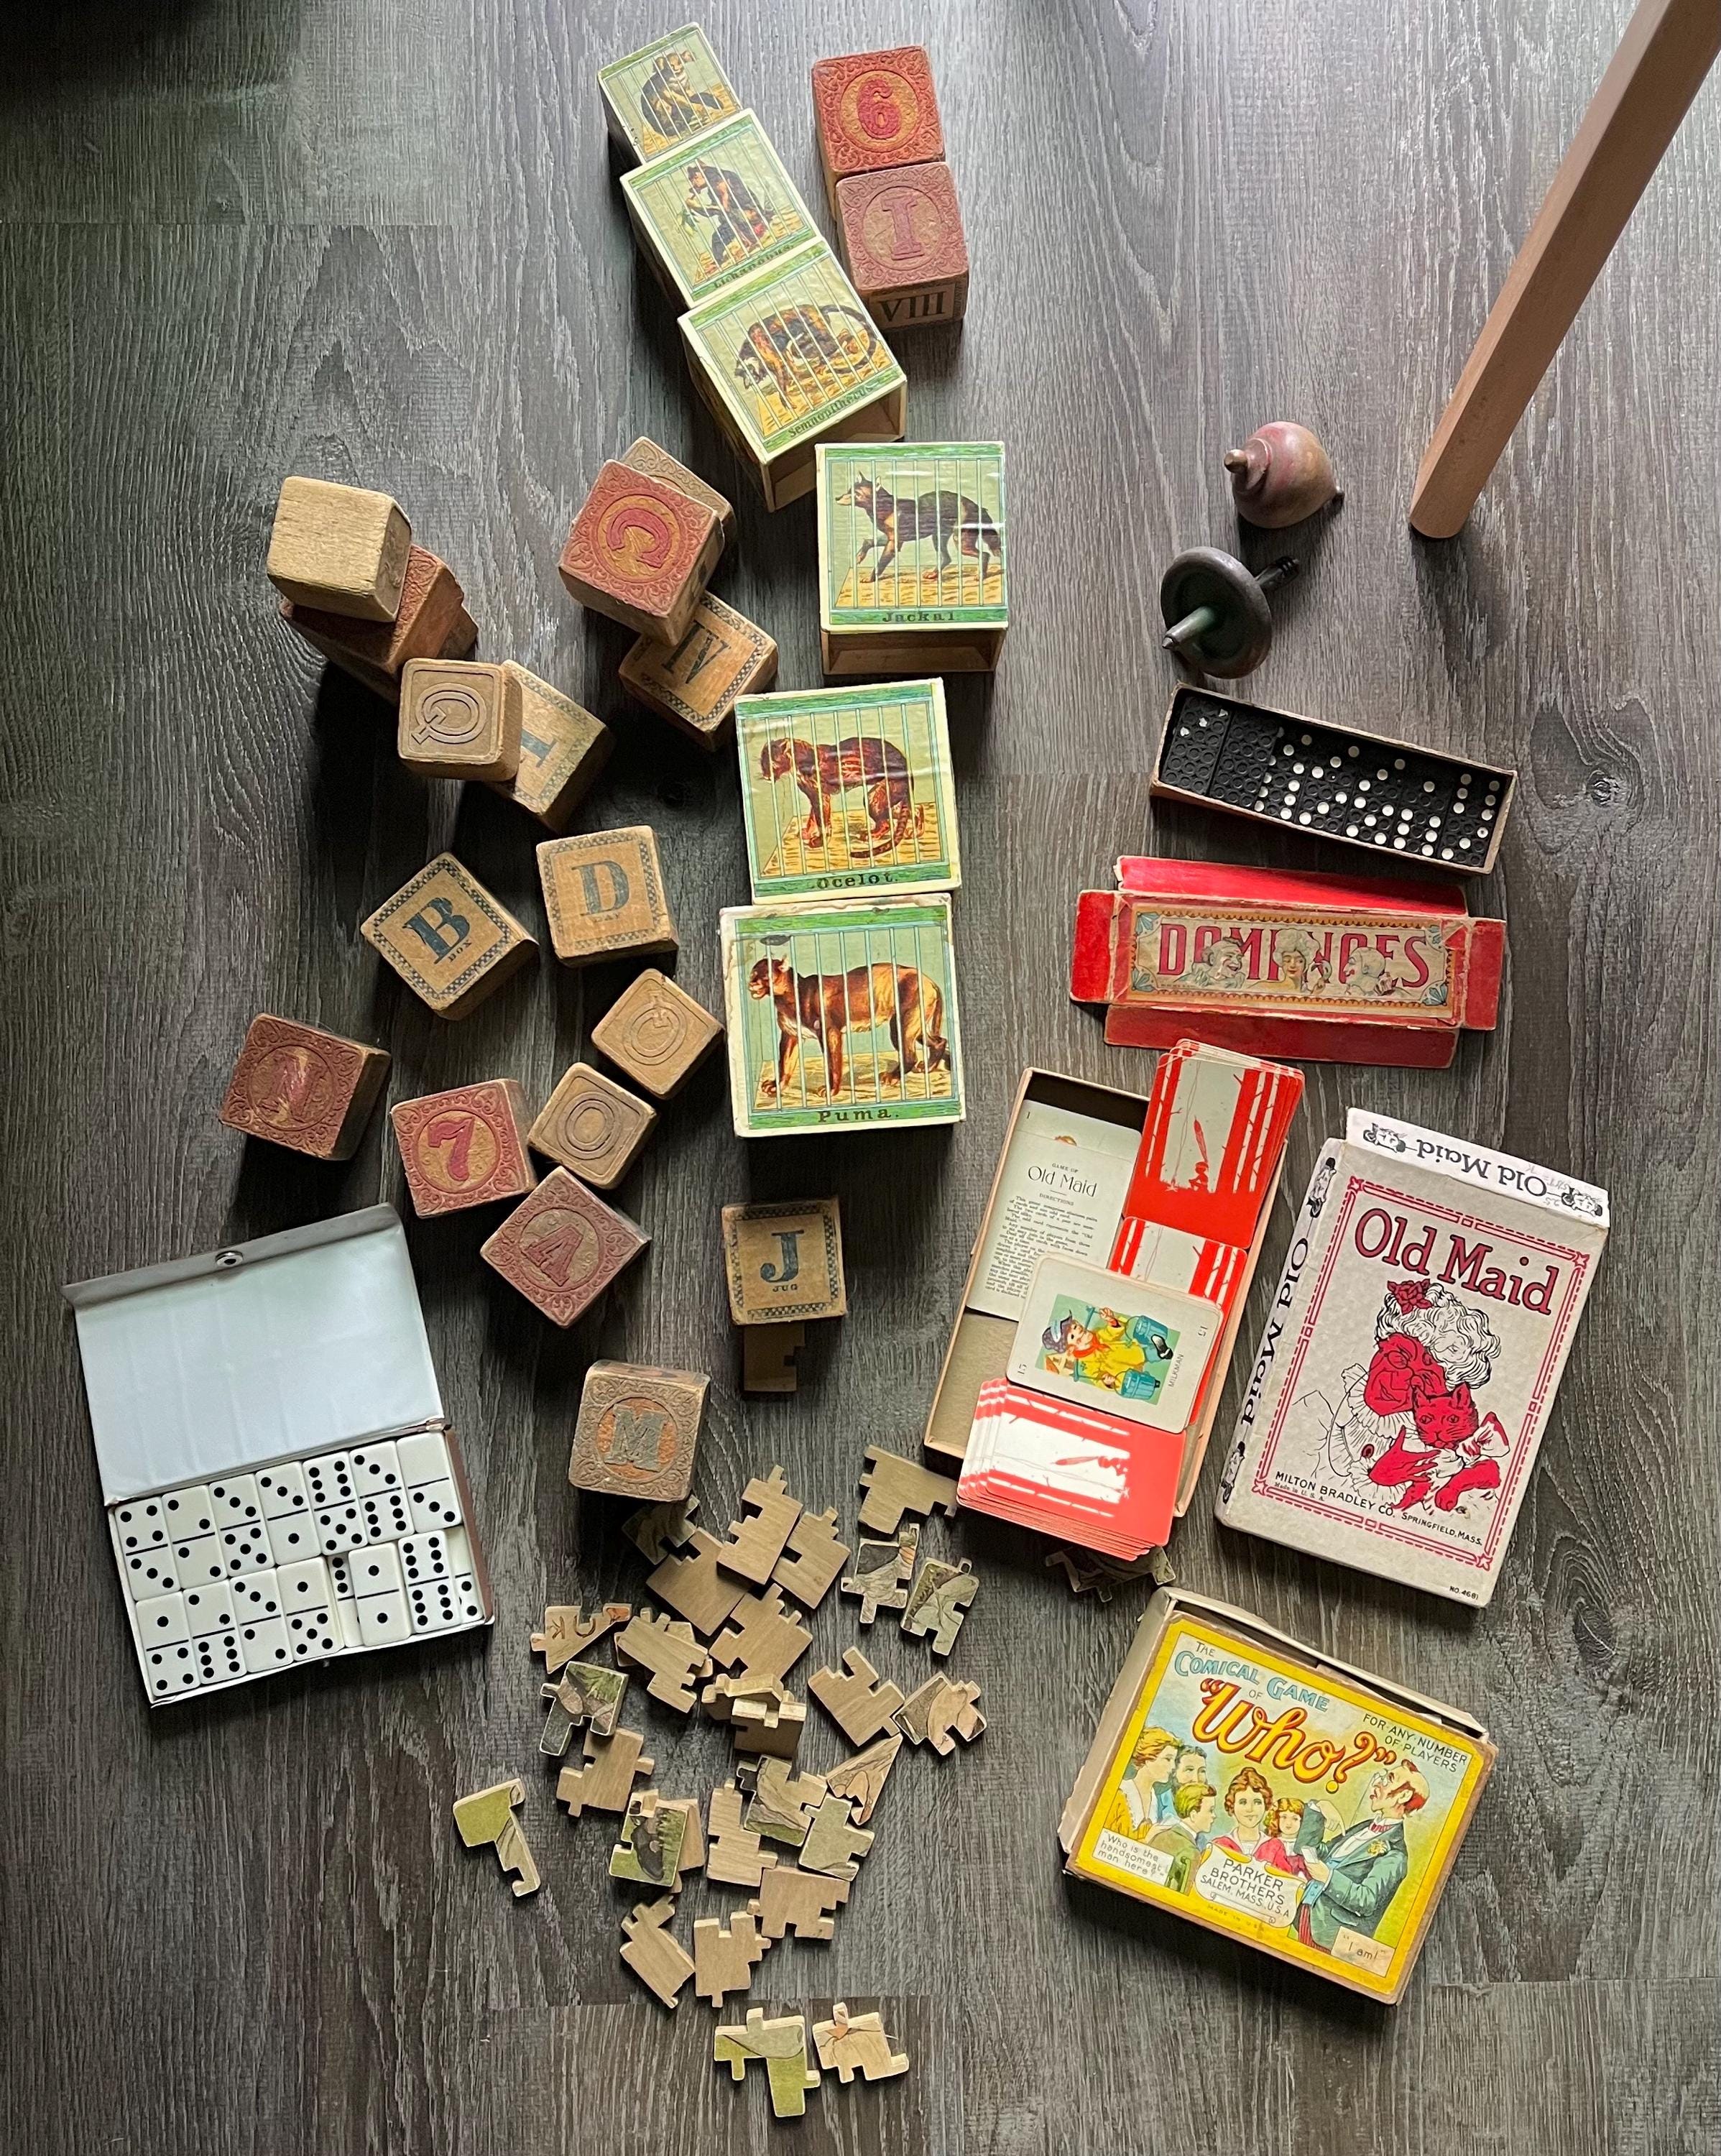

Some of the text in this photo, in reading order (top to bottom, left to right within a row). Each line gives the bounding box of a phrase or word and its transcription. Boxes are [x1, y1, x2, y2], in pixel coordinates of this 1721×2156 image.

[857, 78, 902, 140] 6
[882, 194, 924, 260] I
[879, 291, 945, 323] VIII
[606, 507, 672, 568] C
[882, 611, 954, 622] Jackal
[411, 683, 486, 745] Q
[571, 860, 629, 918] D
[816, 872, 898, 890] Ocelot.
[402, 897, 471, 964] B
[448, 941, 472, 963] BOX
[818, 1107, 900, 1123] Puma.
[429, 1117, 476, 1182] 7
[1028, 1166, 1097, 1197] Old Maid
[1416, 1138, 1549, 1198] Old Maid
[1038, 1193, 1074, 1205] DIRECTIONS
[522, 1222, 585, 1287] A
[760, 1230, 804, 1283] J
[1354, 1210, 1560, 1315] Old Maid
[772, 1284, 798, 1292] JUG
[1197, 1326, 1208, 1337] 15
[1241, 1237, 1309, 1428] Old Maid
[1168, 1354, 1184, 1387] MILKMAN
[611, 1404, 667, 1470] M
[1275, 1470, 1316, 1491] MILTON
[1319, 1485, 1375, 1511] BRADLEY
[1377, 1505, 1396, 1518] CO.
[1457, 1531, 1484, 1546] MASS.
[1460, 1589, 1479, 1600] 4681
[1196, 1641, 1216, 1657] THE
[1174, 1650, 1330, 1713] COMICAL GAME
[1248, 1690, 1263, 1700] OF
[1362, 1713, 1467, 1765] FOR ANY NUMBER
[1385, 1736, 1457, 1772] OF PLAYERS
[1098, 1850, 1119, 1864] man
[1101, 1840, 1162, 1871] handsomest
[1143, 1849, 1158, 1862] the
[1210, 1868, 1285, 1905] BROTHERS
[1223, 1858, 1283, 1892] PARKER
[1207, 1904, 1227, 1916] MADE
